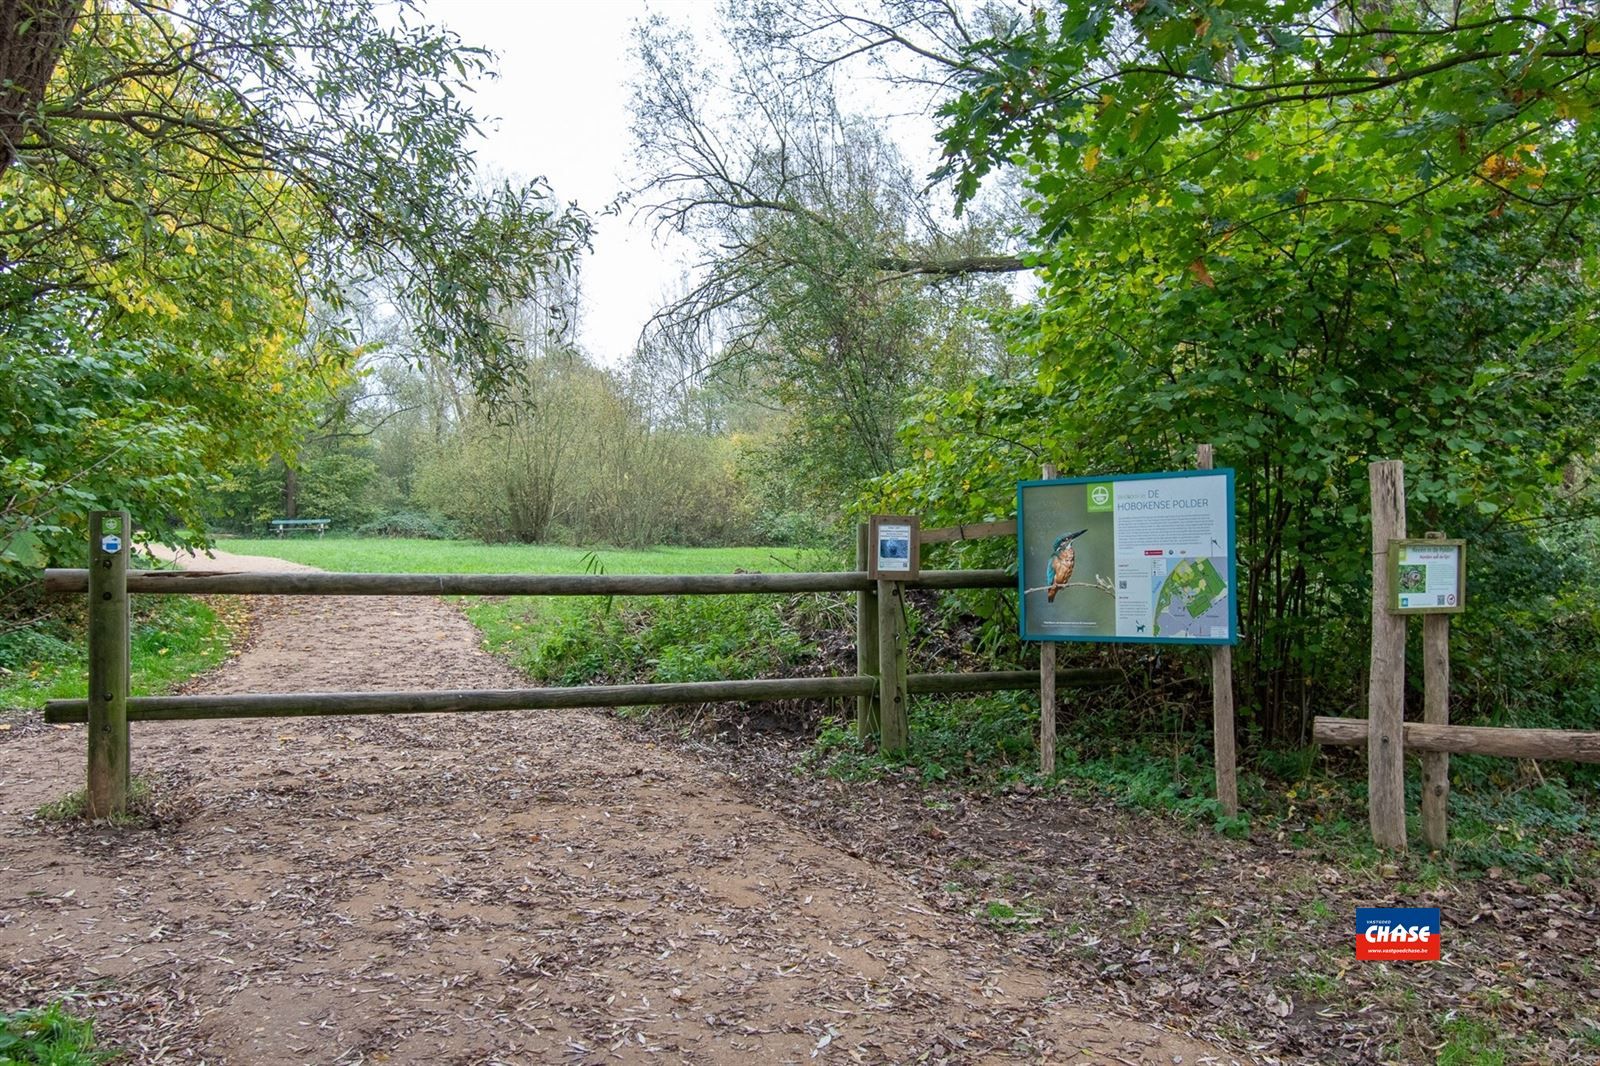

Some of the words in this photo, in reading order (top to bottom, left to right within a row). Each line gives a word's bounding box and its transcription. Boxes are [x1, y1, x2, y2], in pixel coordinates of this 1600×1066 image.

[1147, 489, 1160, 499] DE
[1117, 500, 1171, 511] HOBOKENSE
[1172, 498, 1209, 508] POLDER
